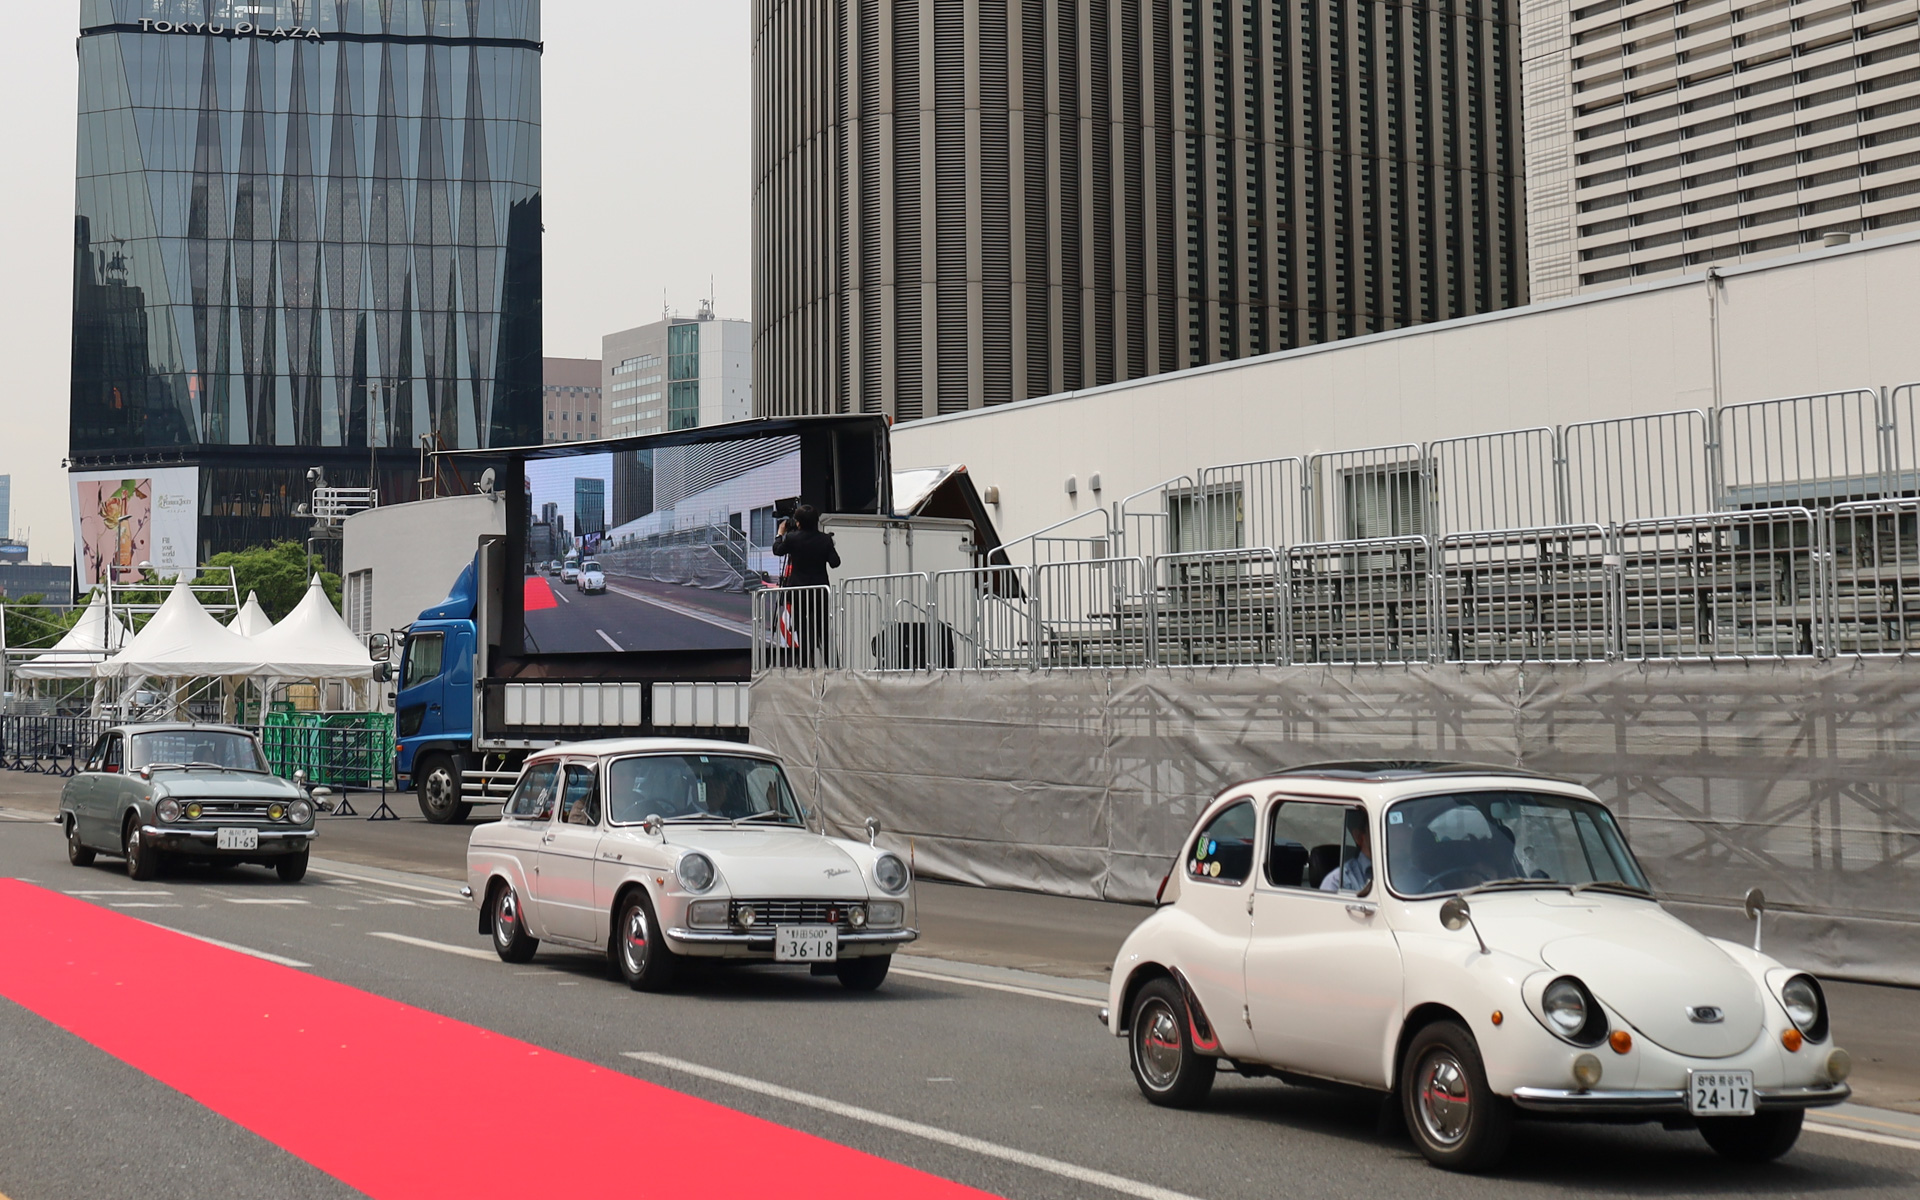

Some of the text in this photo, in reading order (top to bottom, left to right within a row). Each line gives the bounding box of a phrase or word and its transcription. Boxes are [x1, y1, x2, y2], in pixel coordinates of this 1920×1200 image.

[138, 17, 321, 39] TOKYU PLAZA
[790, 941, 833, 957] 36-18
[1697, 1088, 1749, 1109] 24-17
